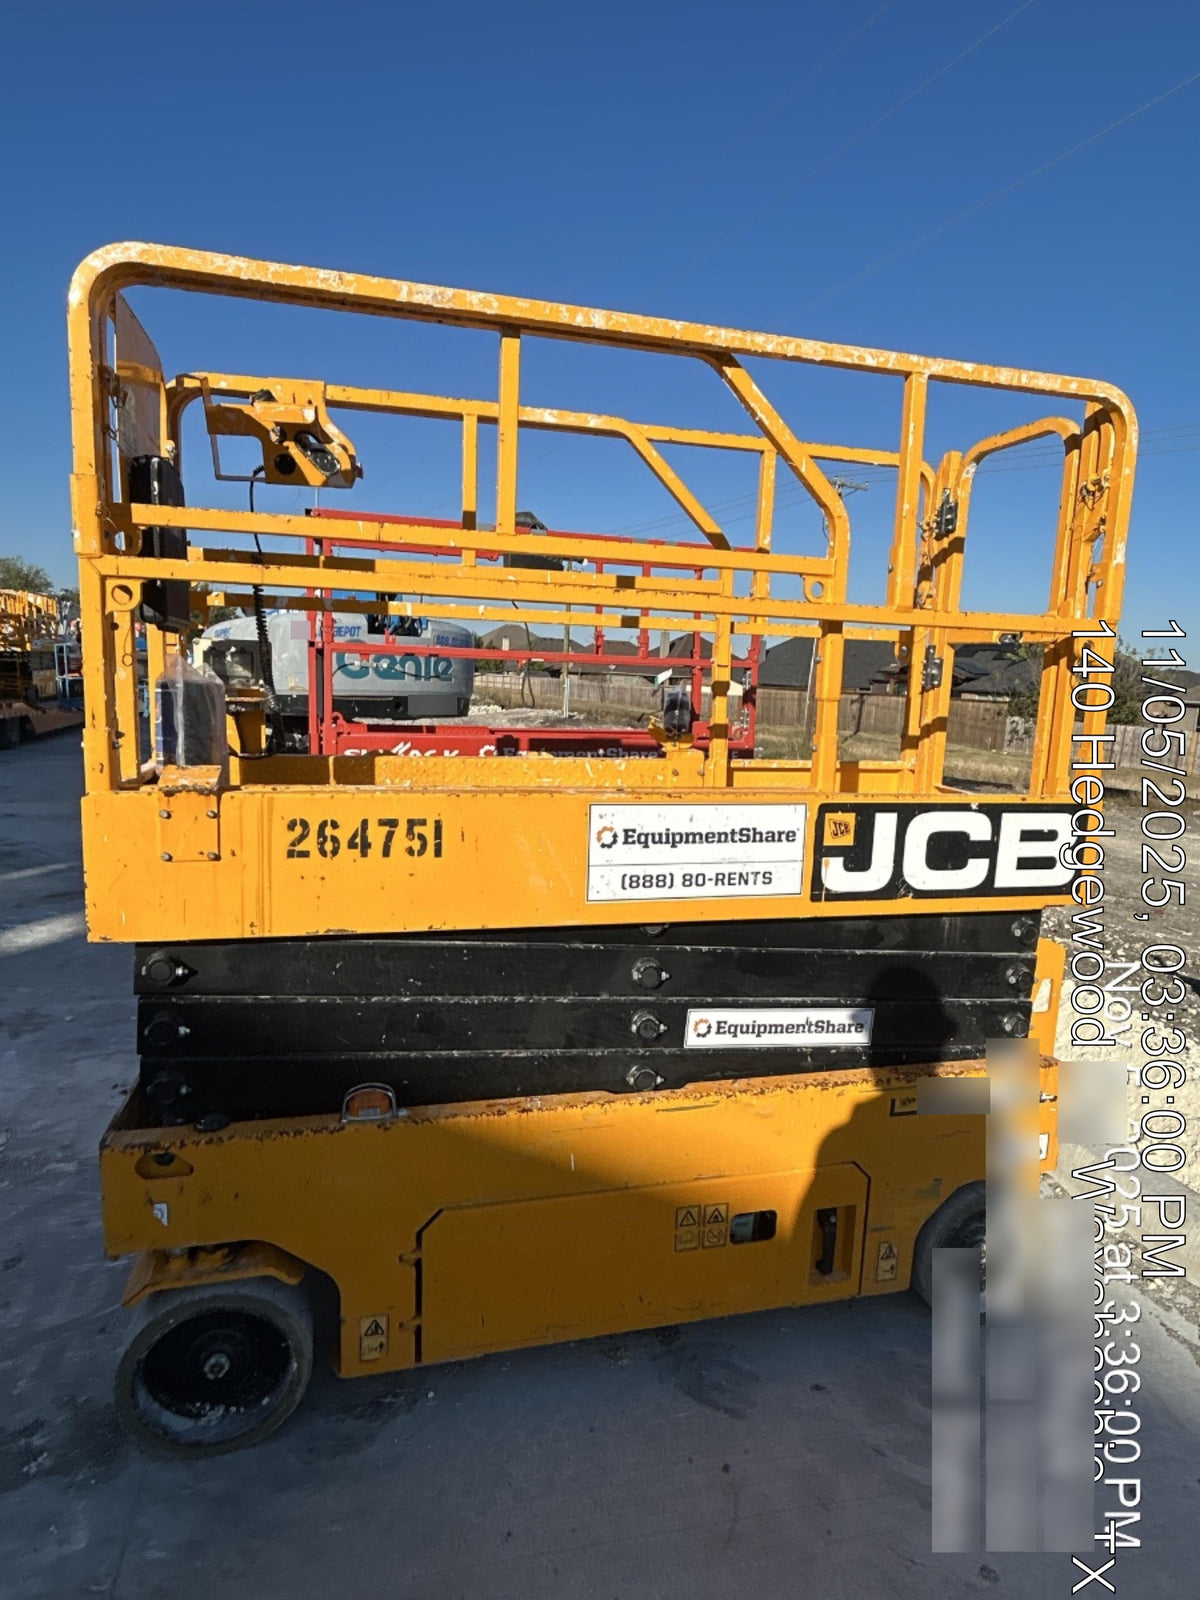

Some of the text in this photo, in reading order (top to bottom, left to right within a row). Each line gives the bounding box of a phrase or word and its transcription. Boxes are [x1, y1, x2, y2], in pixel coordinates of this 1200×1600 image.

[503, 747, 659, 759] EqpmentShare
[285, 817, 443, 859] 264751
[622, 827, 798, 849] EquipmentShare
[831, 820, 851, 837] JCB
[820, 810, 1078, 894] JCB
[620, 870, 774, 890] (888) 80-RENTS
[714, 1018, 865, 1039] EquipmentShare
